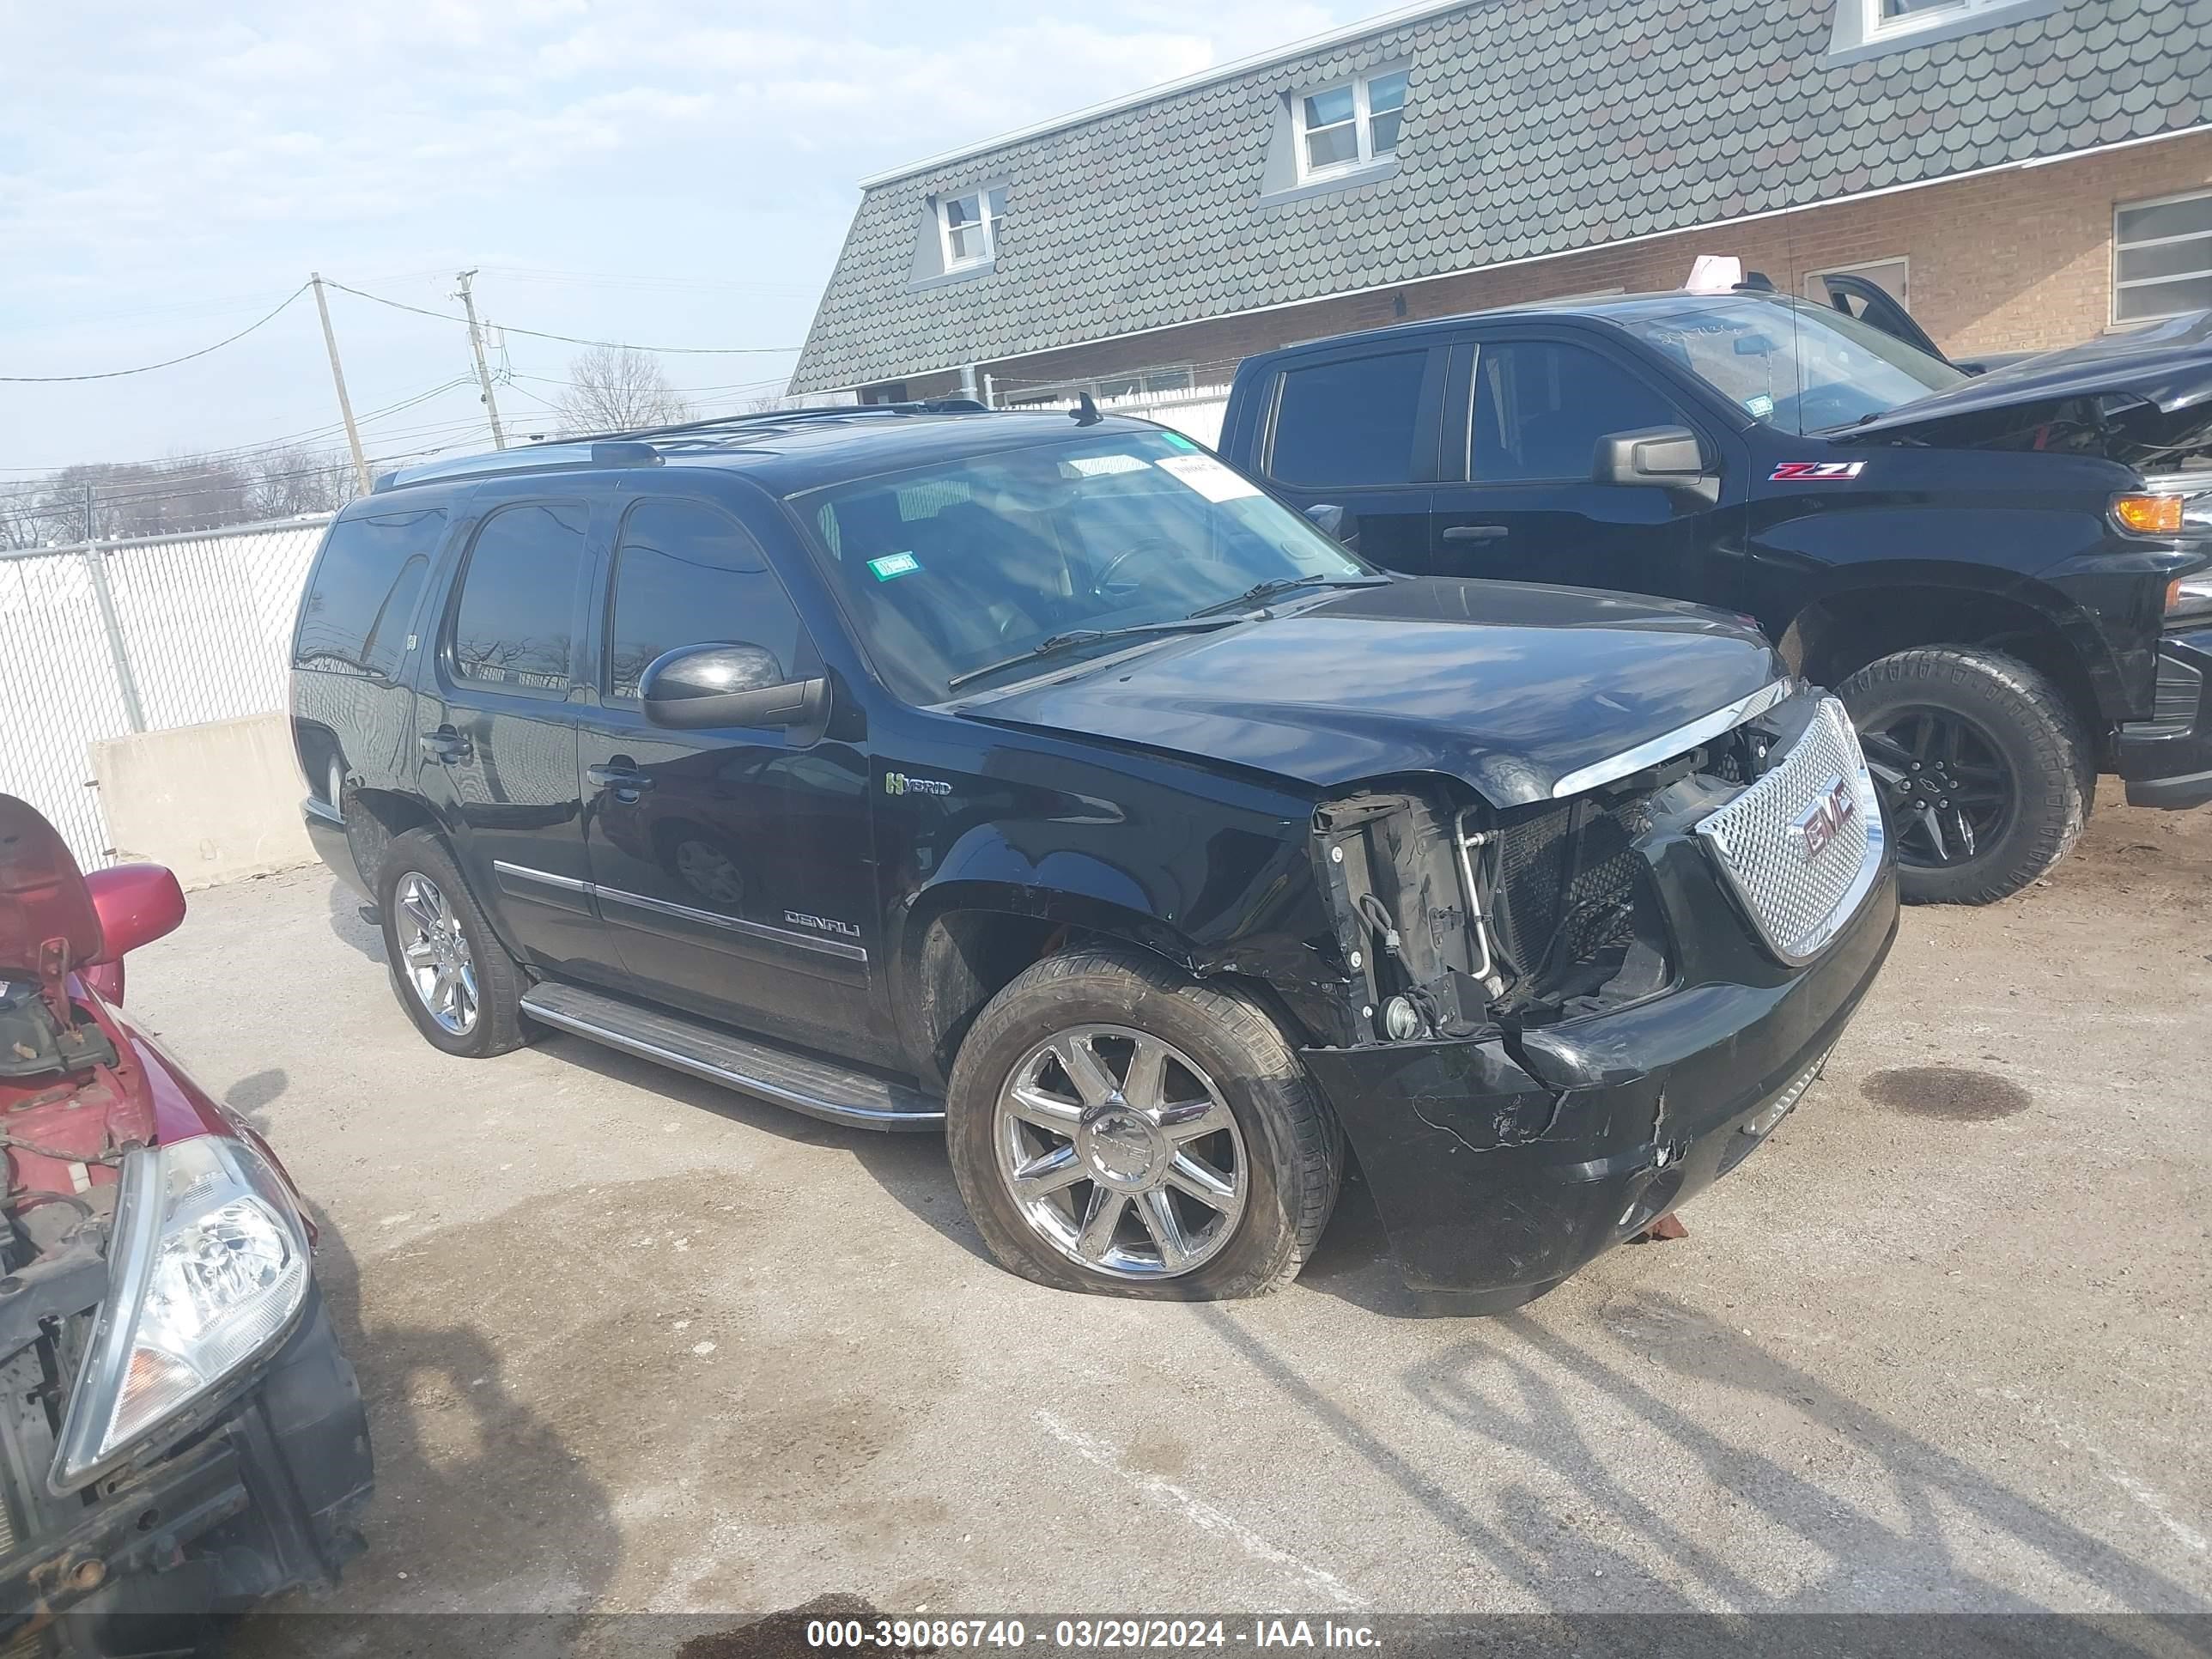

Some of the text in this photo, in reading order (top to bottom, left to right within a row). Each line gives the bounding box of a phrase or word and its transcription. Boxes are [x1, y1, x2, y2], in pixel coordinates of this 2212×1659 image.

[1767, 461, 1868, 480] Z71
[1793, 774, 1854, 858] GMC
[783, 910, 860, 938] DENALI
